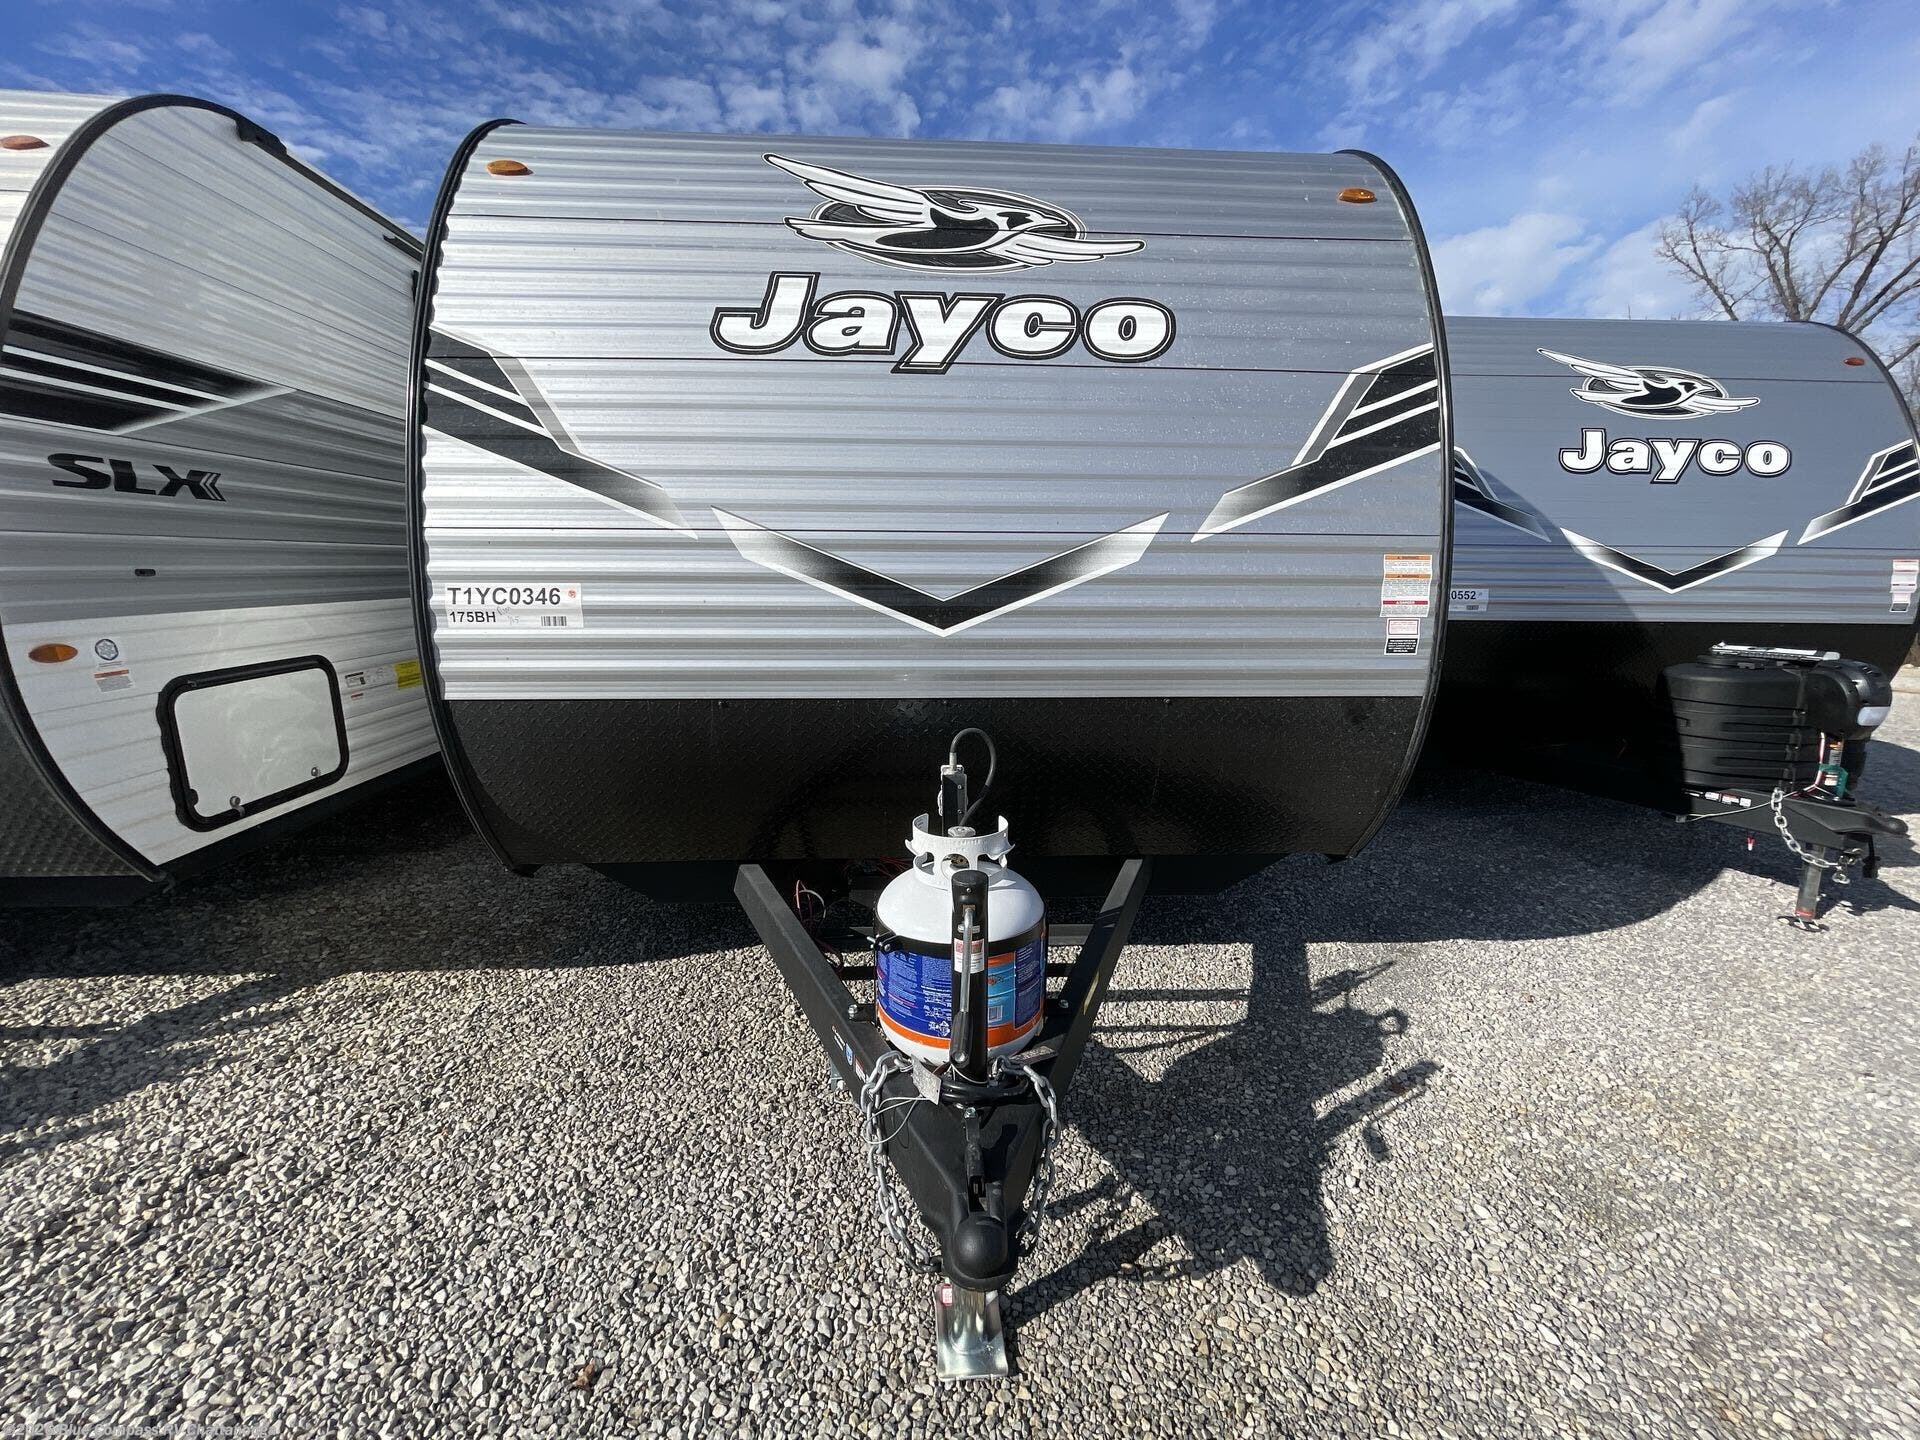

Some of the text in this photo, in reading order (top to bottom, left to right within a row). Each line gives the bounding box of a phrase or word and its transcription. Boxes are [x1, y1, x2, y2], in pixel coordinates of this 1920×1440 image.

[710, 271, 1177, 374] Jayco
[1559, 428, 1793, 484] Jayco
[47, 453, 226, 501] SLX
[447, 587, 561, 605] T1YC0346
[1449, 590, 1476, 600] 0552
[449, 611, 496, 623] 175BH
